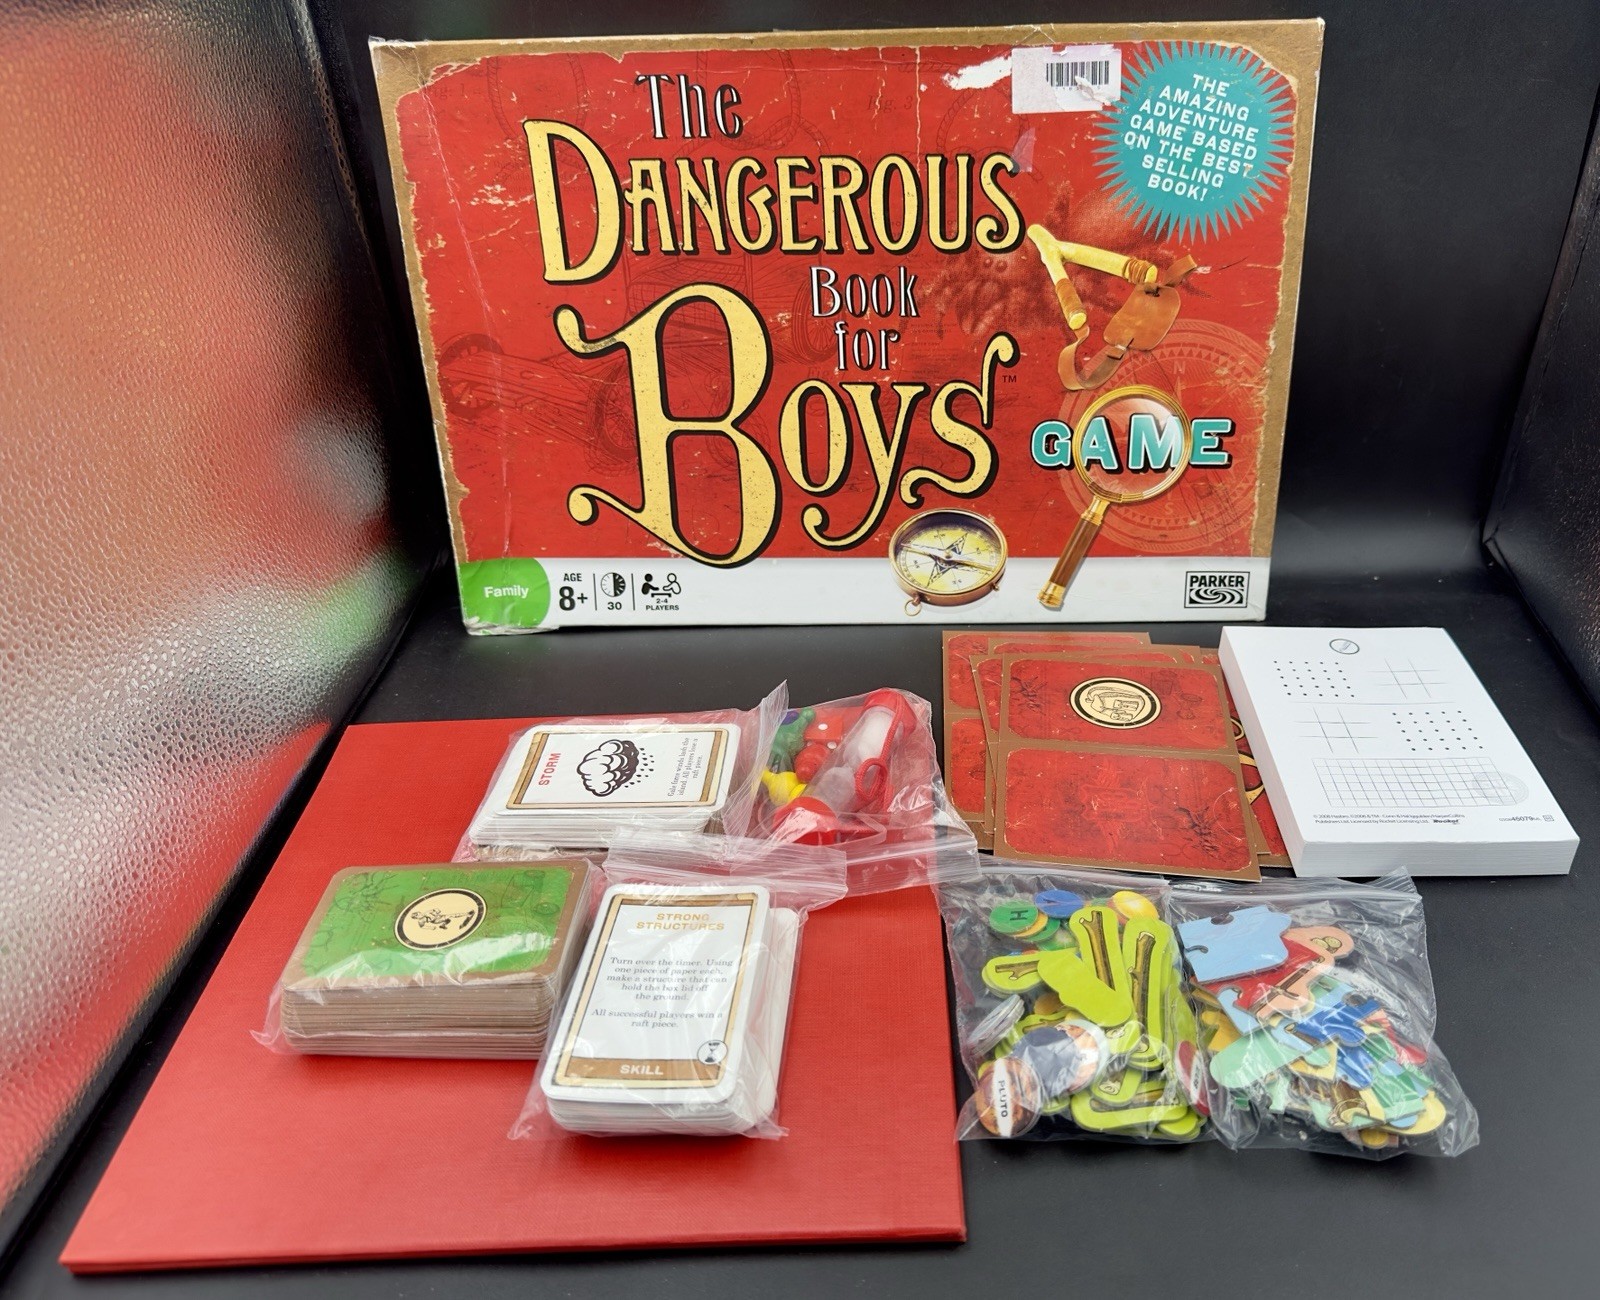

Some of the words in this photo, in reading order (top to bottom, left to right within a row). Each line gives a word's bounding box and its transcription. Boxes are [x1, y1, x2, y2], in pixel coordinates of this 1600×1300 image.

[1192, 73, 1230, 98] THE
[634, 74, 742, 139] The
[1158, 85, 1250, 122] AMAZING
[1139, 98, 1259, 143] ADVENTURE
[1130, 114, 1187, 142] GAME
[1192, 131, 1258, 161] BASED
[1124, 131, 1151, 150] ON
[1159, 139, 1196, 163] THE
[1201, 152, 1254, 178] BEST
[1141, 154, 1225, 189] SELLING
[1147, 173, 1208, 201] BOOK!
[521, 118, 1026, 286] DANGEROUS
[808, 264, 919, 319] Book
[833, 320, 900, 372] for
[553, 282, 1021, 569] Boys
[1030, 412, 1236, 475] GAME
[563, 572, 583, 582] AGE
[1189, 575, 1245, 588] PARKER
[484, 584, 530, 599] Family
[558, 585, 588, 611] 8+
[607, 601, 623, 611] 30
[645, 603, 680, 611] PLAYERS
[538, 752, 562, 787] STORM
[636, 921, 725, 931] STRUCTURES
[656, 913, 710, 922] STRONG
[610, 956, 633, 966] Turn
[658, 958, 673, 966] the
[633, 967, 657, 975] piece
[660, 967, 670, 975] of
[606, 974, 632, 982] make
[621, 983, 643, 991] hold
[644, 984, 660, 992] the
[662, 984, 679, 992] box
[696, 984, 709, 992] off
[635, 992, 651, 1000] the
[591, 1008, 606, 1017] All
[608, 1009, 657, 1018] successful
[659, 1010, 695, 1020] players
[631, 1019, 649, 1028] raft
[620, 1064, 664, 1076] SKILL
[998, 1079, 1010, 1119] PLUTO
